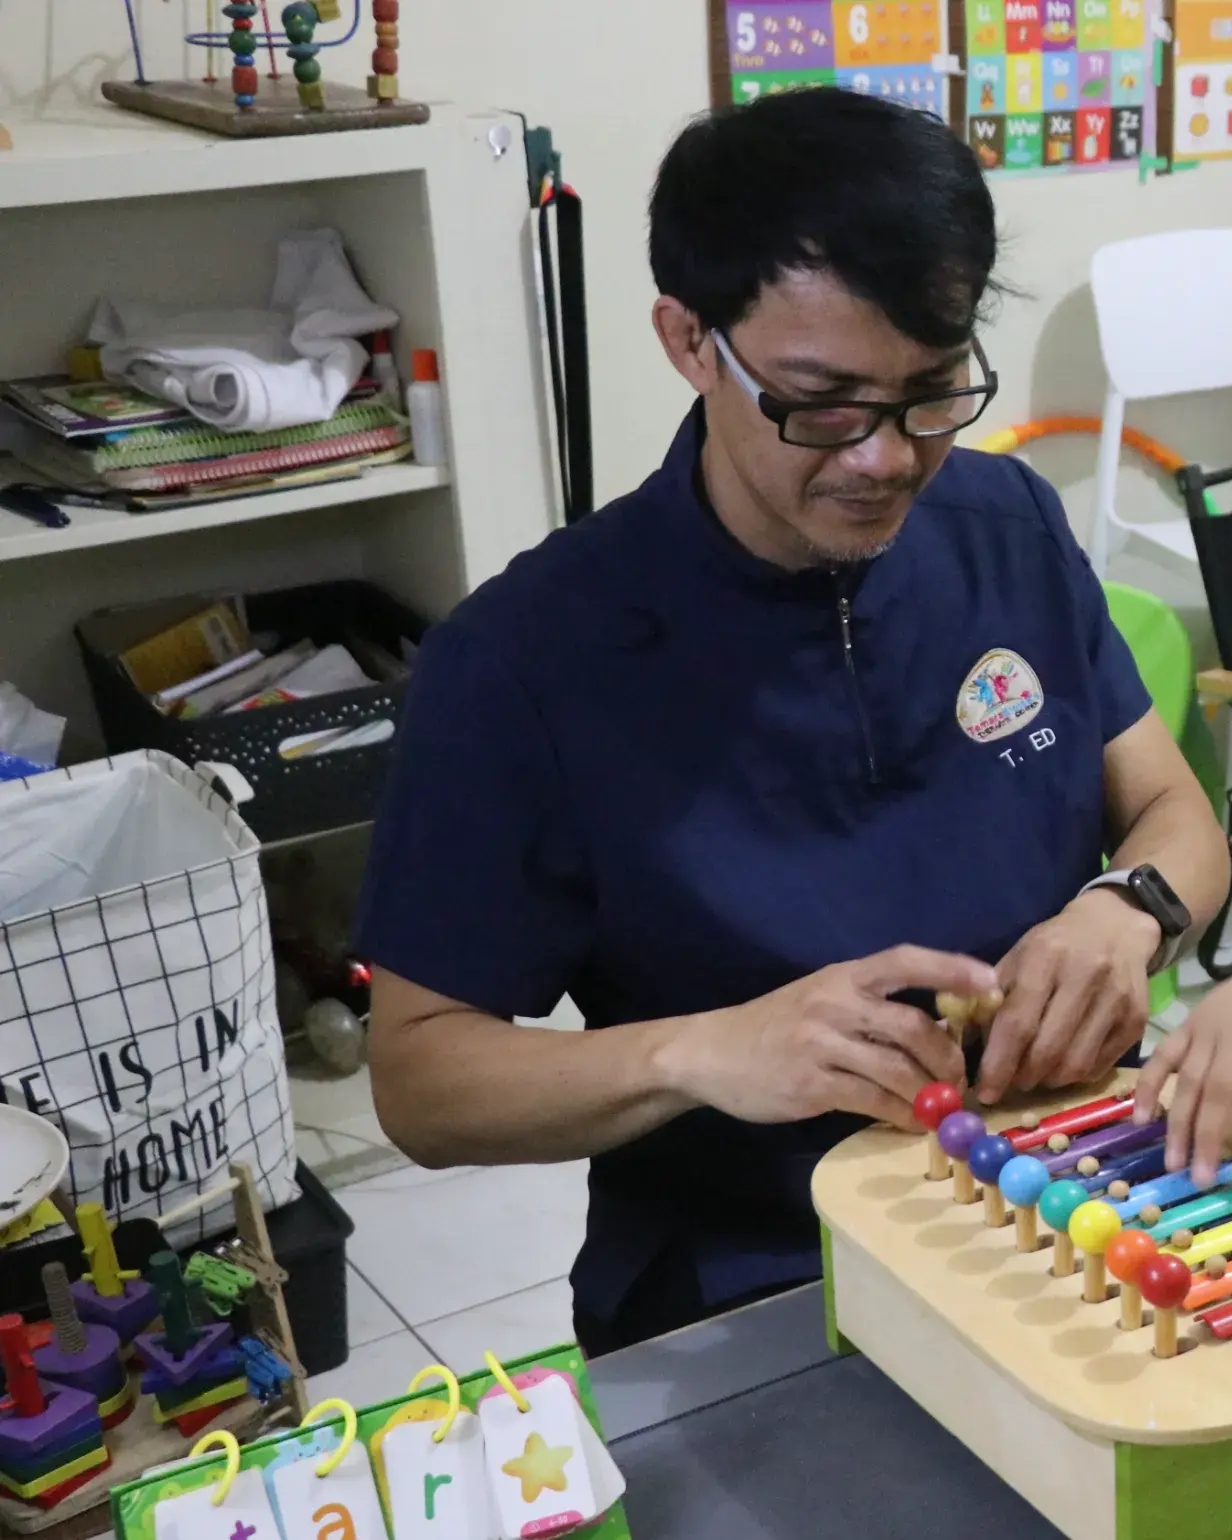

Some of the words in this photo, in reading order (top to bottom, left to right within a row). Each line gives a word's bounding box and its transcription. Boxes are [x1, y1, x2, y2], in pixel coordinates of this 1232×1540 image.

[849, 4, 869, 44] 6
[1006, 3, 1038, 20] Mm
[1047, 0, 1071, 17] Nn
[737, 12, 757, 52] 5
[974, 120, 996, 138] Vv
[1007, 119, 1040, 135] Ww
[1050, 115, 1071, 133] Xx
[1086, 114, 1105, 133] Yy
[1120, 111, 1139, 129] Zz
[998, 748, 1024, 768] T.
[1029, 728, 1056, 751] ED
[100, 1041, 153, 1113] IS
[195, 998, 239, 1072] IN
[103, 1095, 230, 1211] HOME
[424, 1472, 453, 1520] r
